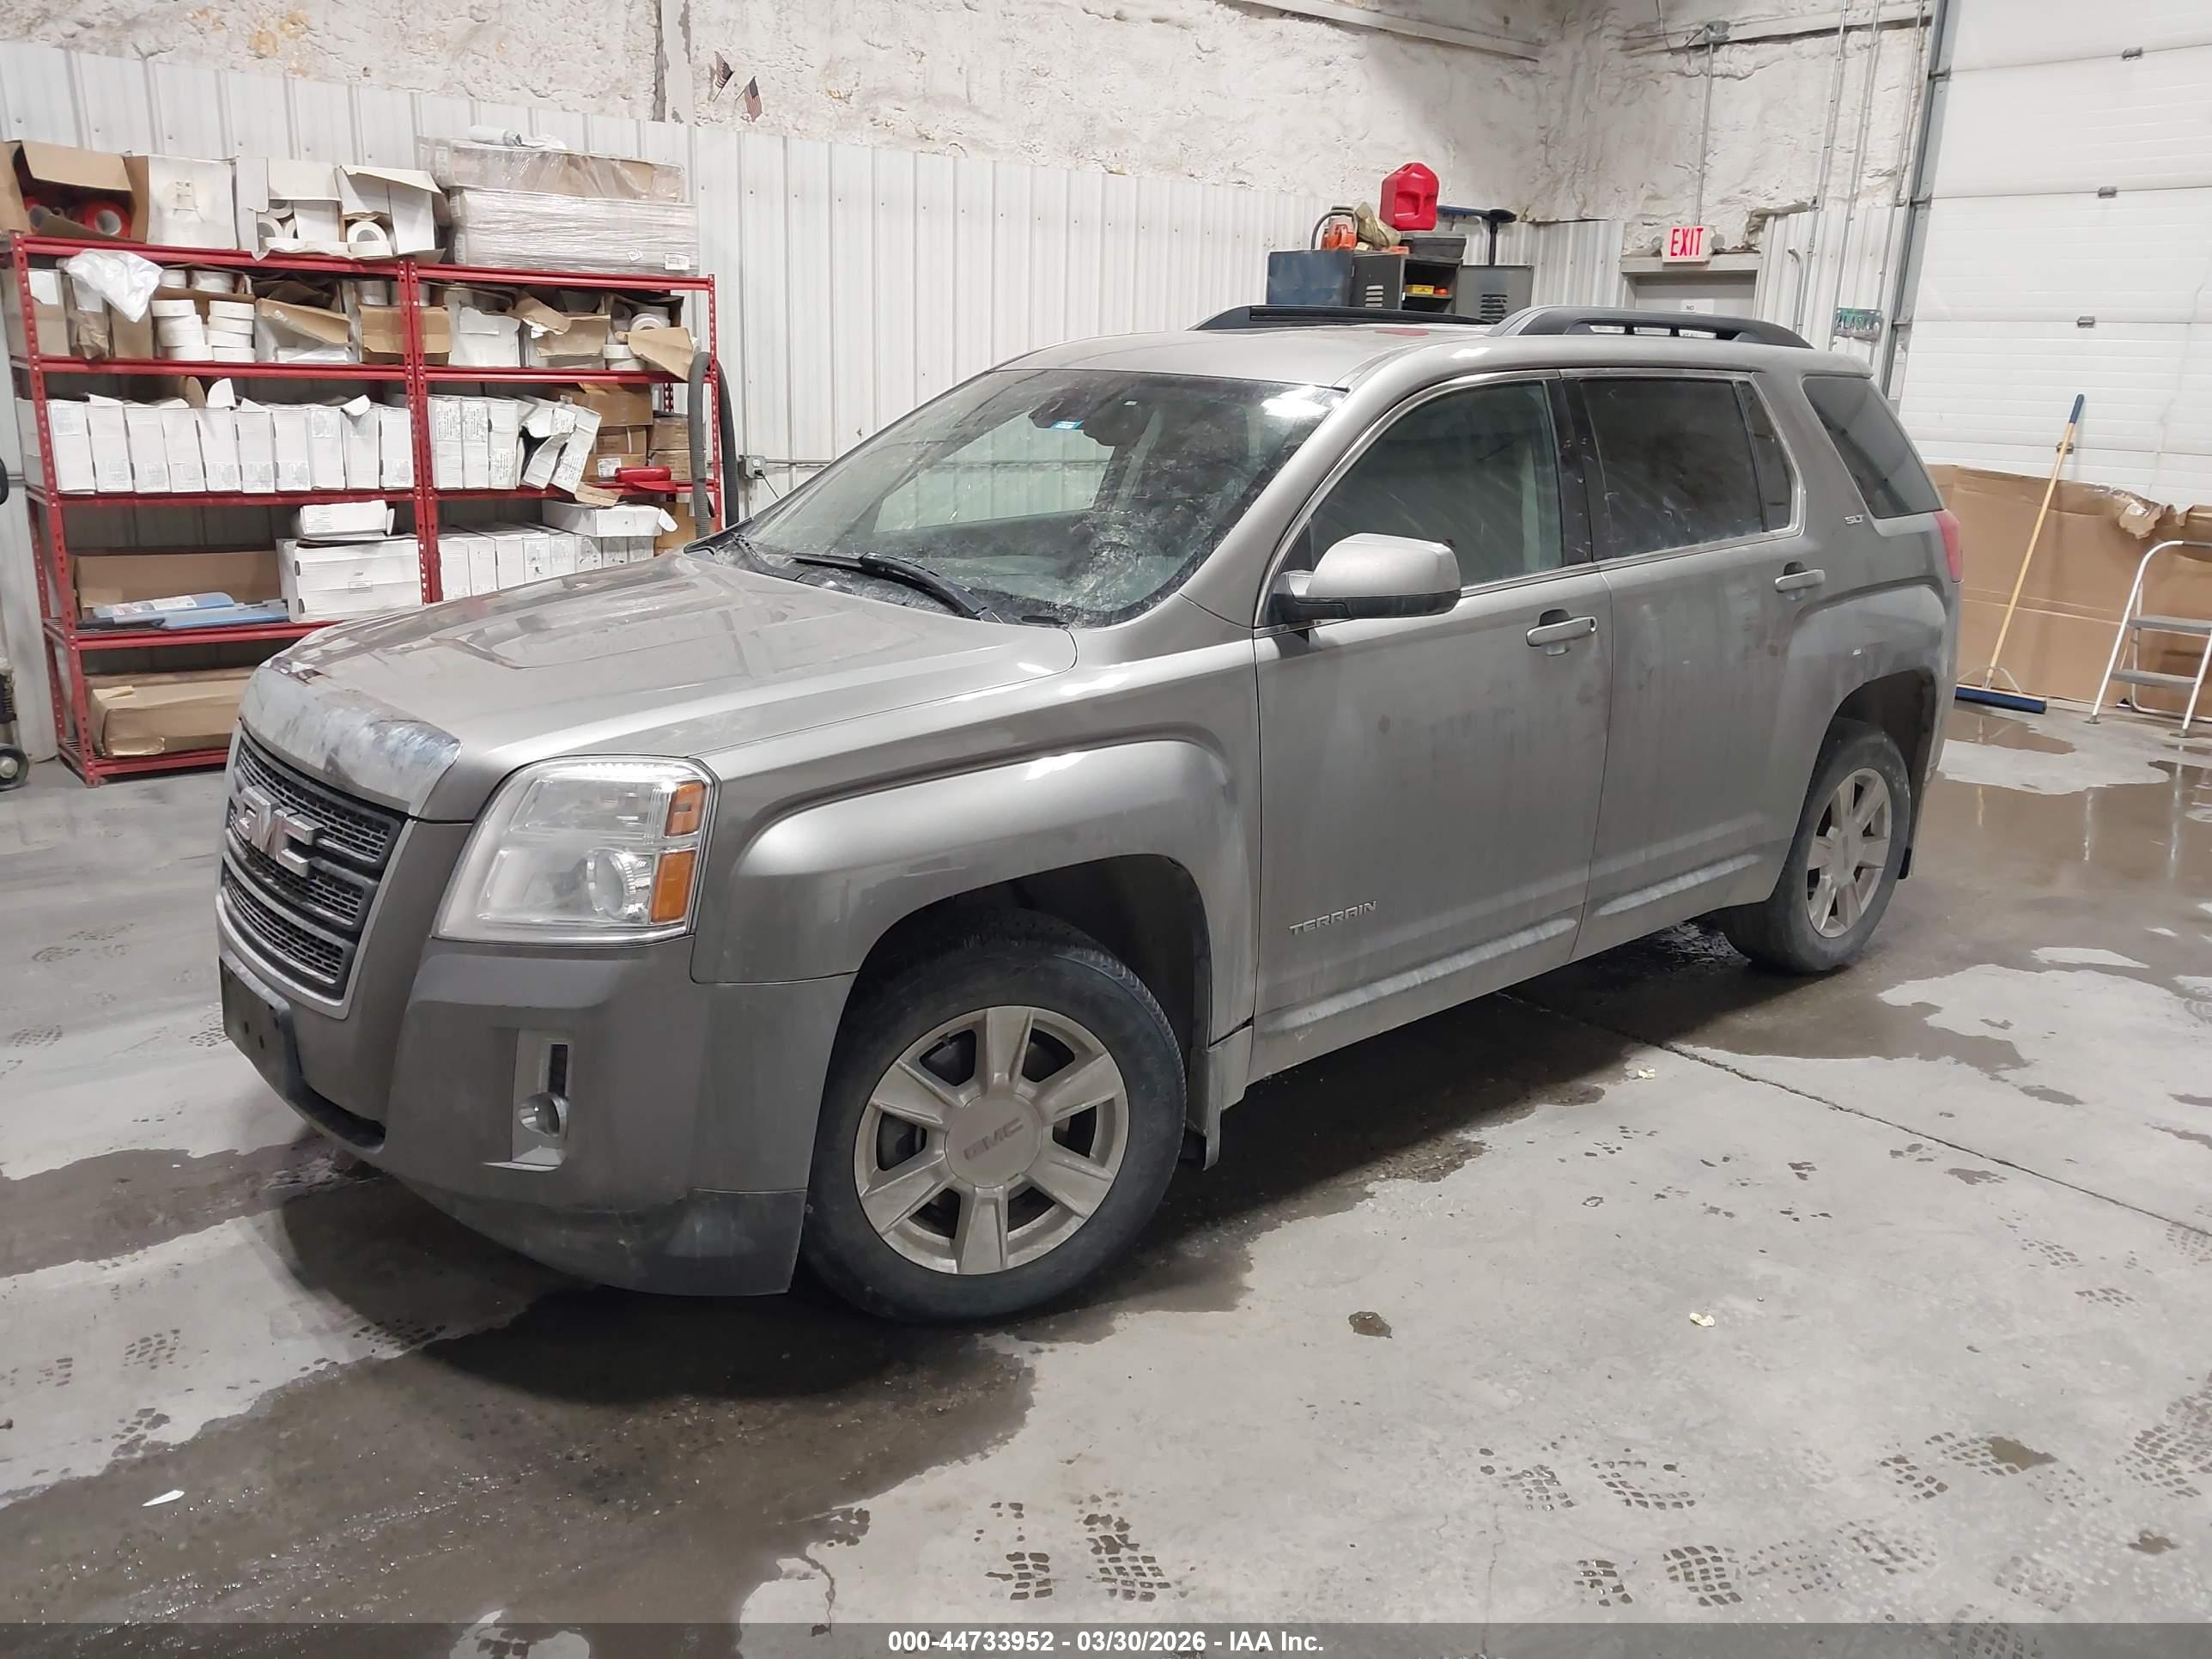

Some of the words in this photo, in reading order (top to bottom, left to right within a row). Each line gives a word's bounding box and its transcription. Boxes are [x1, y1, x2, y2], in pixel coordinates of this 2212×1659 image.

[1670, 227, 1705, 257] EXIT
[1844, 514, 1864, 525] SLT
[234, 785, 325, 878] GMC
[1289, 899, 1377, 935] TERRAIN
[963, 1117, 1024, 1161] GMC
